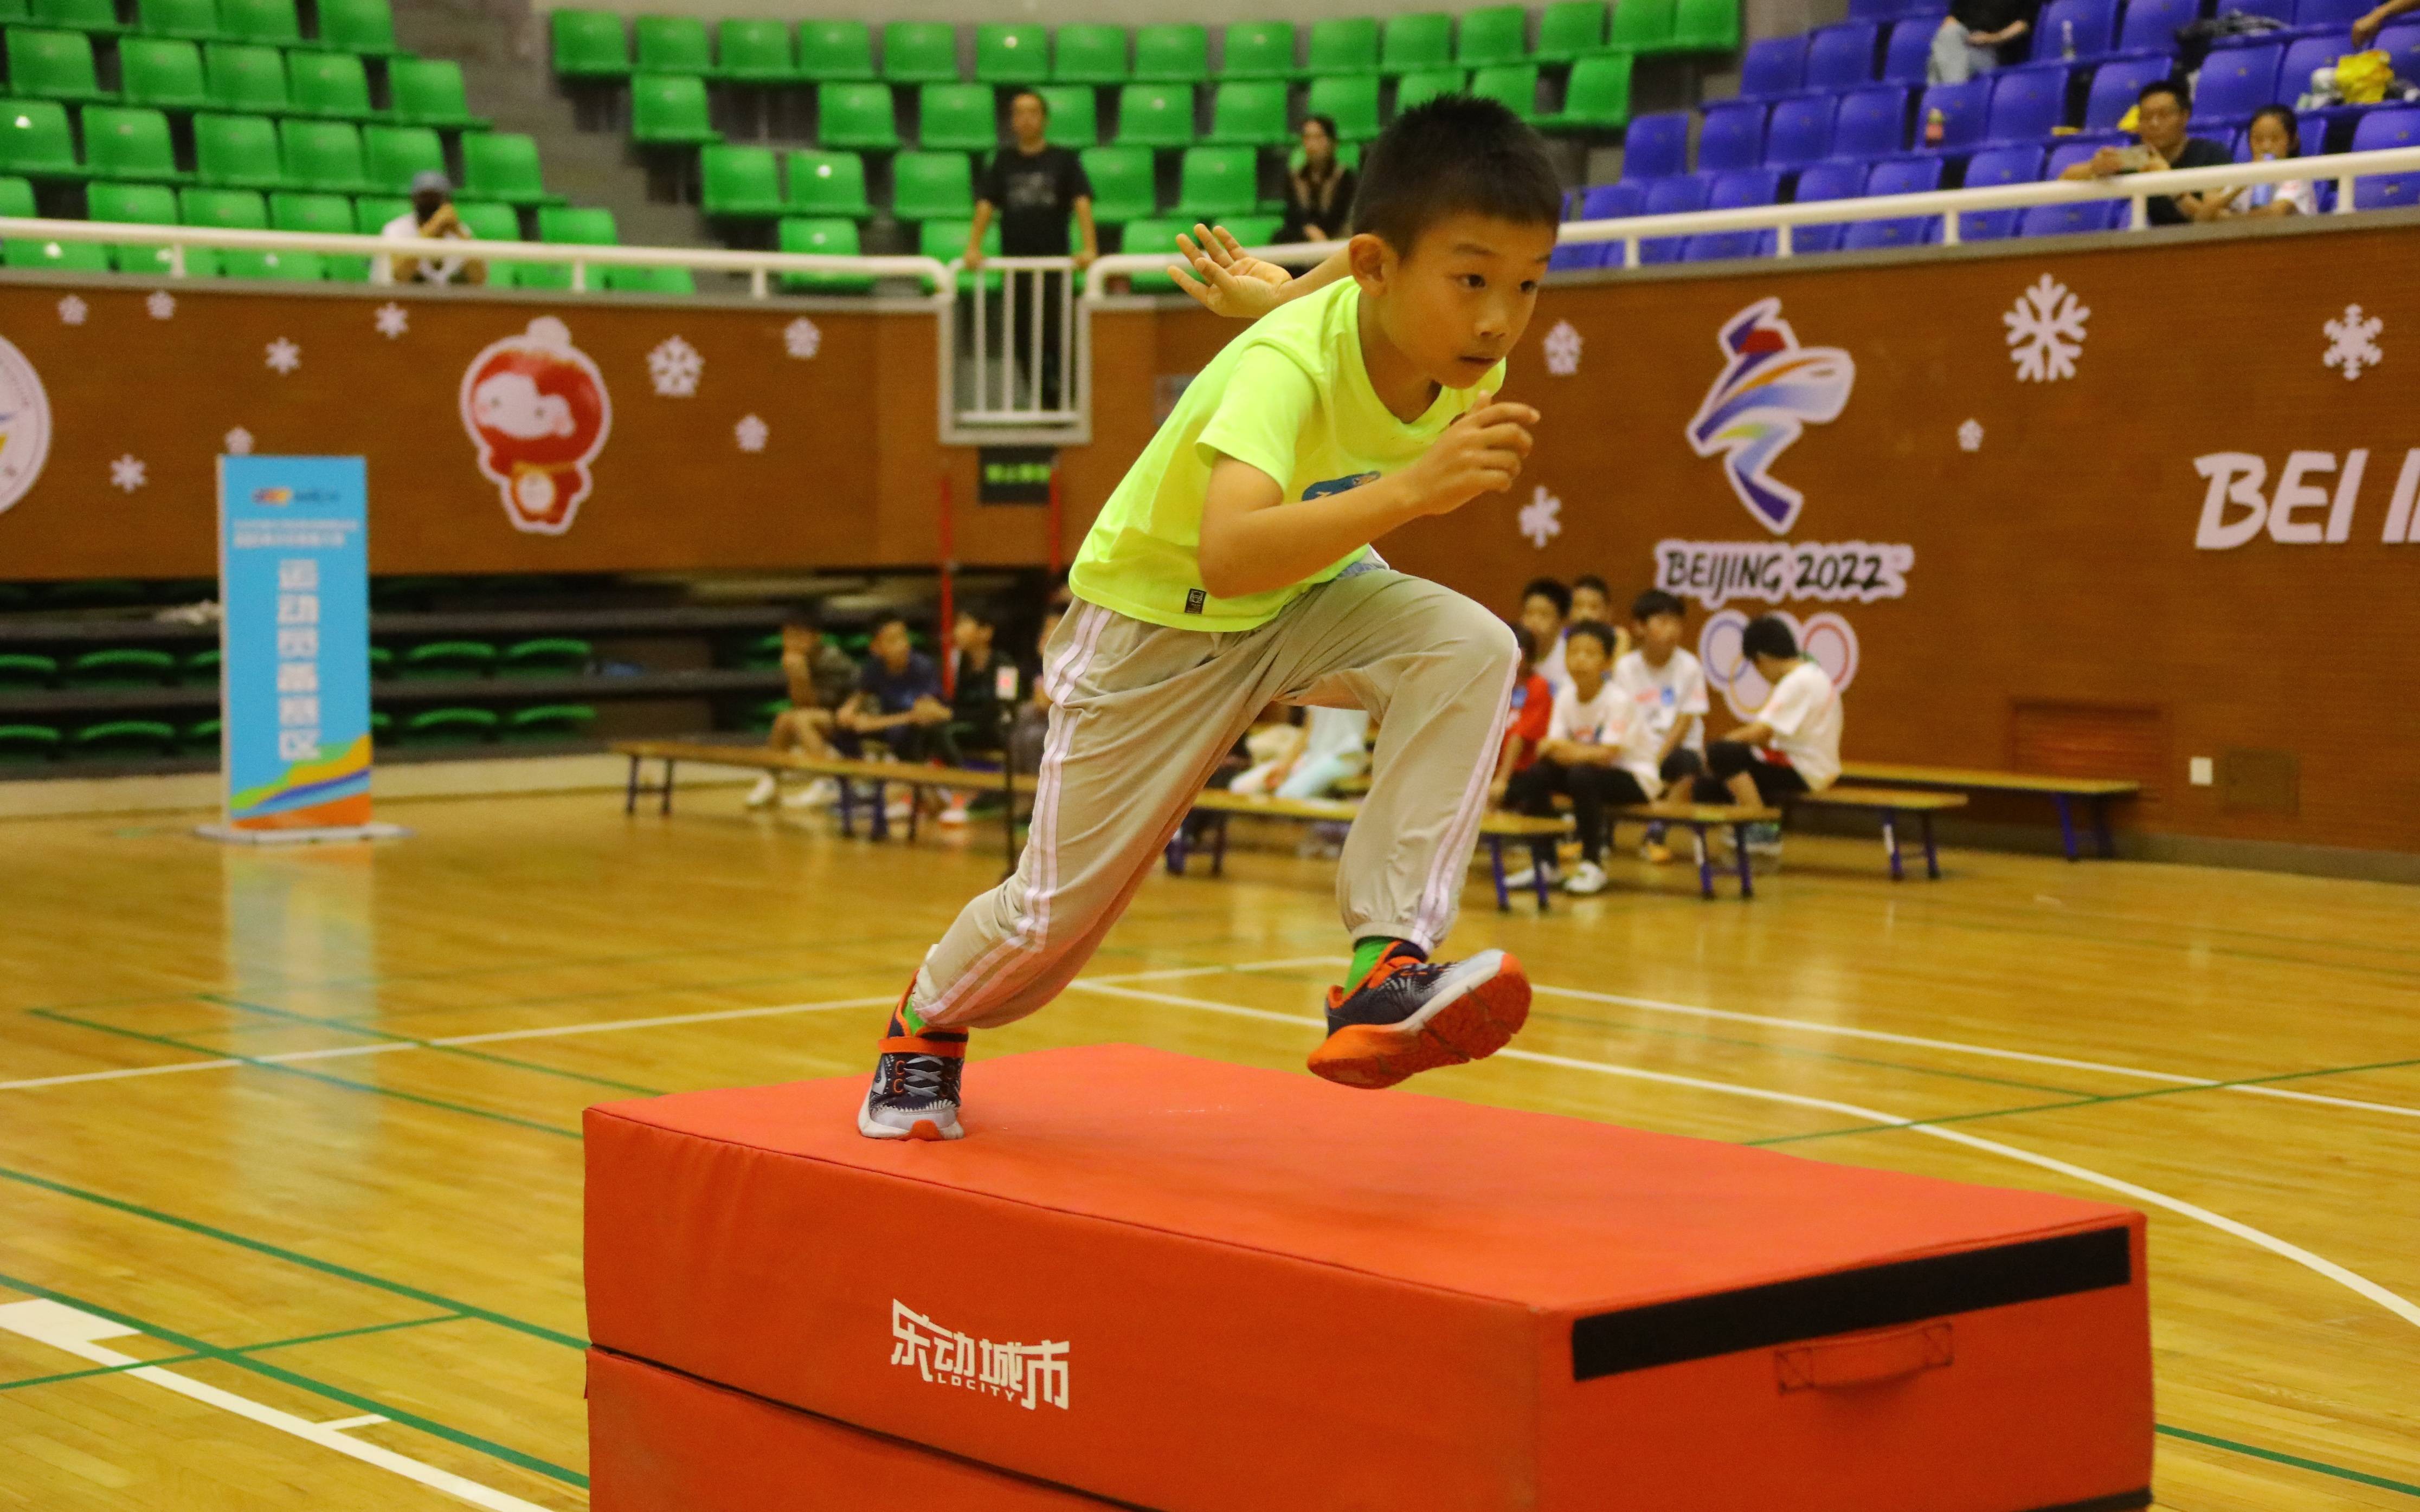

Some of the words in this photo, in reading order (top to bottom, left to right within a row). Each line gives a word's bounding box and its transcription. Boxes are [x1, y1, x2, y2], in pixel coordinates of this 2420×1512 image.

[2193, 448, 2368, 550] BEI
[1664, 550, 1782, 599] BEIJING
[1794, 552, 1888, 591] 2022
[891, 1298, 1070, 1410] 乐动城市
